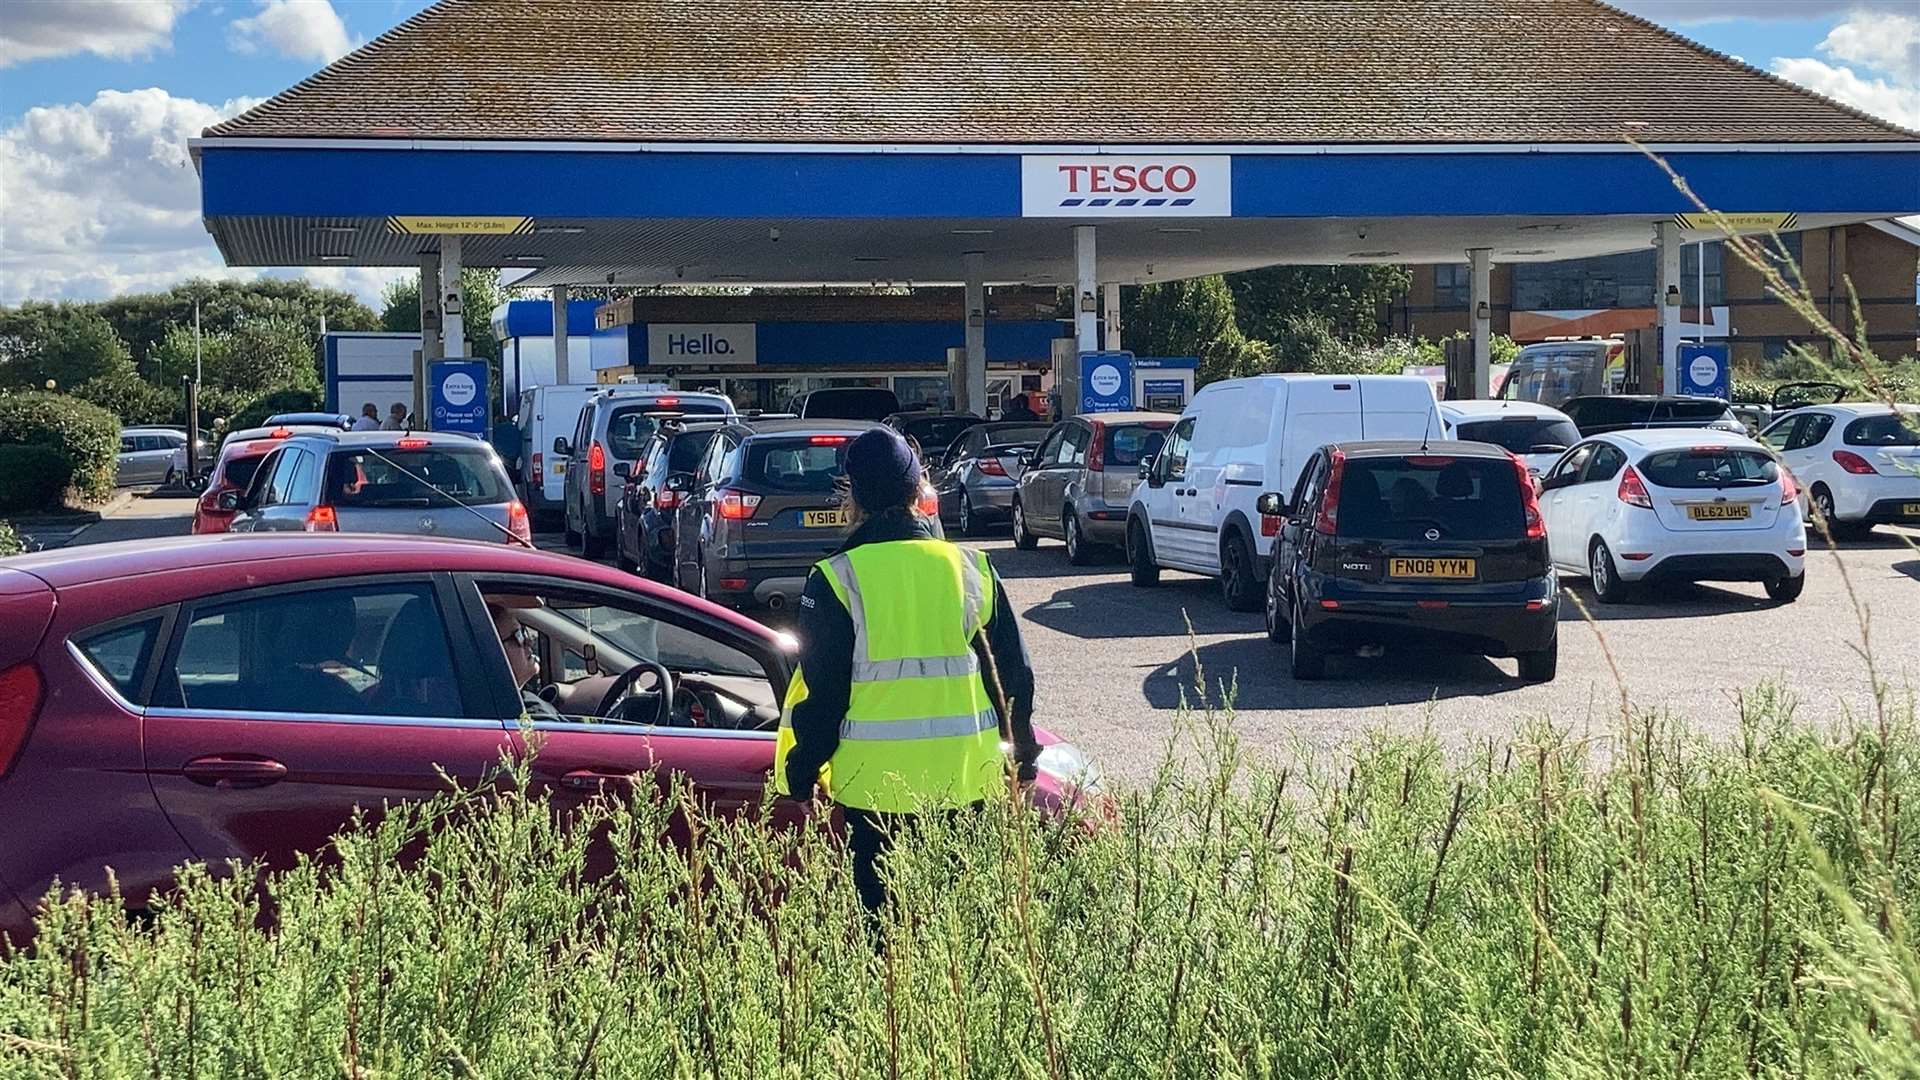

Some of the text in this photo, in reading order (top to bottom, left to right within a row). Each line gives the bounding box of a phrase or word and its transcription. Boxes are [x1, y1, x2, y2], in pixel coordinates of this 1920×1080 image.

[1059, 165, 1196, 193] TESCO
[668, 333, 735, 355] Hello.
[808, 512, 837, 524] YS18
[1395, 559, 1468, 574] FN08 YYM
